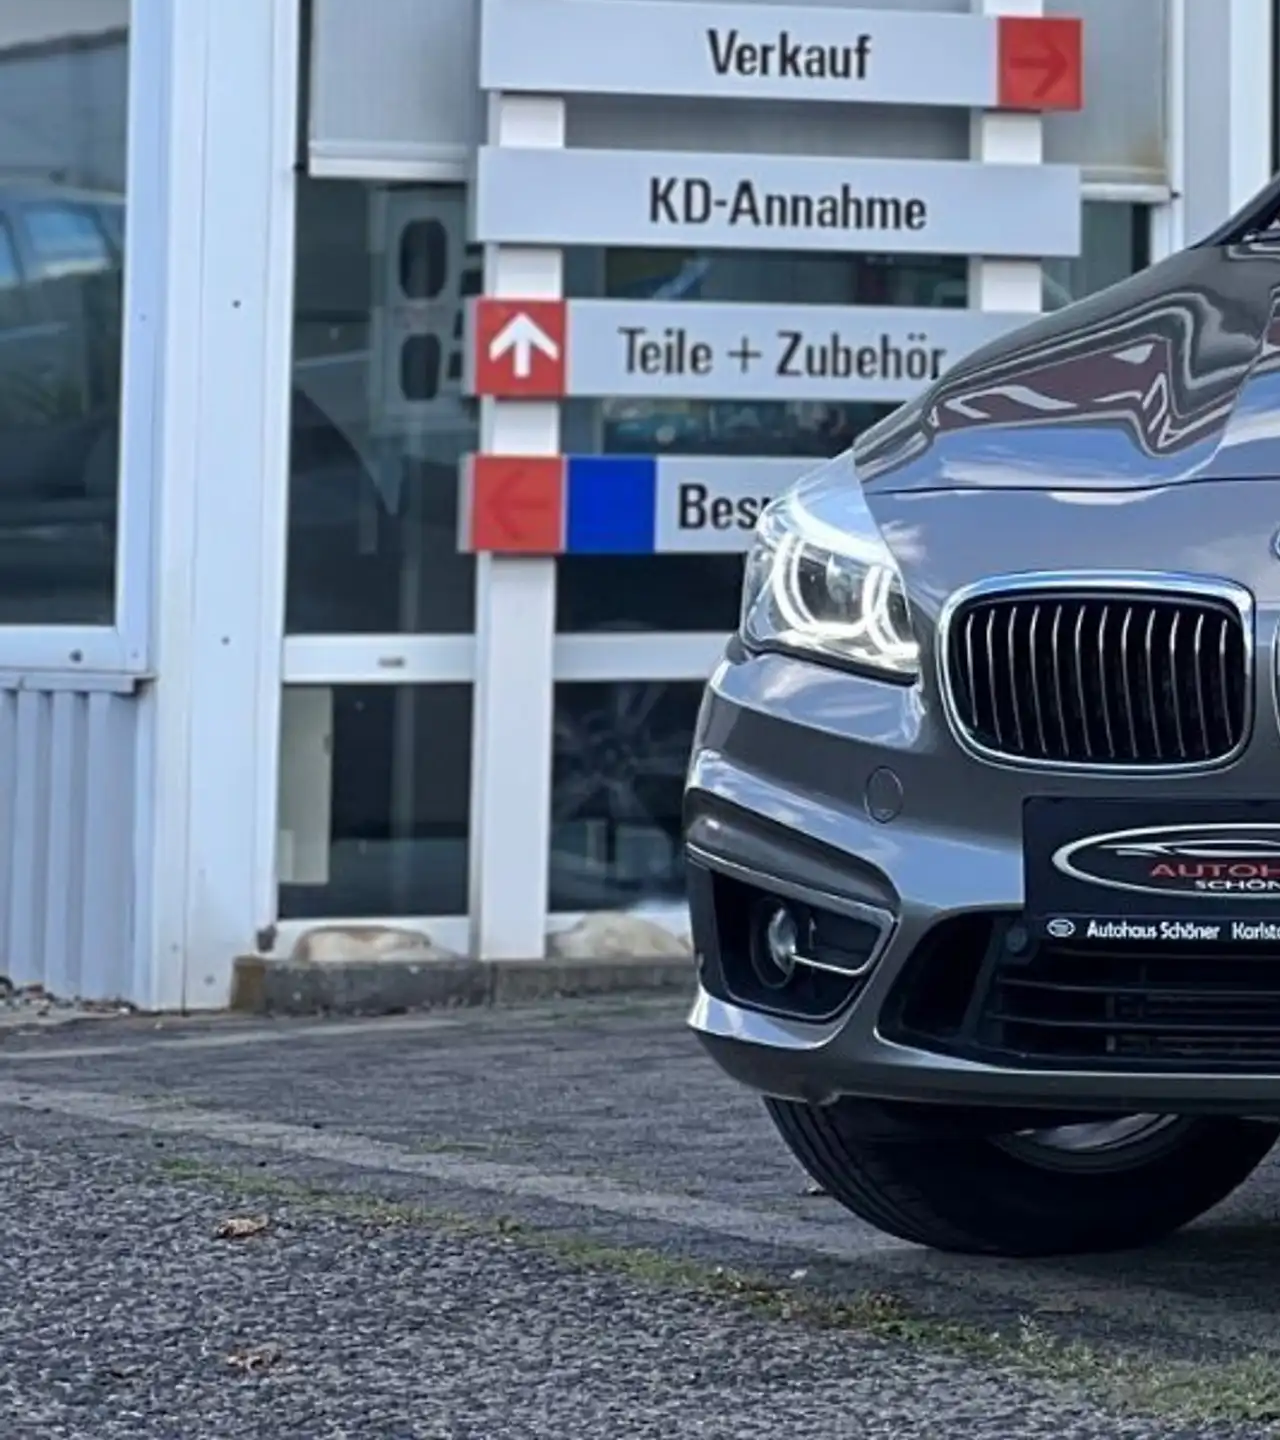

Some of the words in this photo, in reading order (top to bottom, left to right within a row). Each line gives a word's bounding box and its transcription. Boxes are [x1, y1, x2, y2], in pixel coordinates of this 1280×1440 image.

[707, 28, 872, 80] Verkauf
[649, 176, 928, 231] KD-Annahme
[618, 326, 714, 375] Teile
[727, 336, 762, 374] +
[776, 330, 947, 381] Zubehör
[677, 482, 770, 531] Bes
[1086, 920, 1158, 940] Autohaus
[1159, 921, 1221, 940] Schöner
